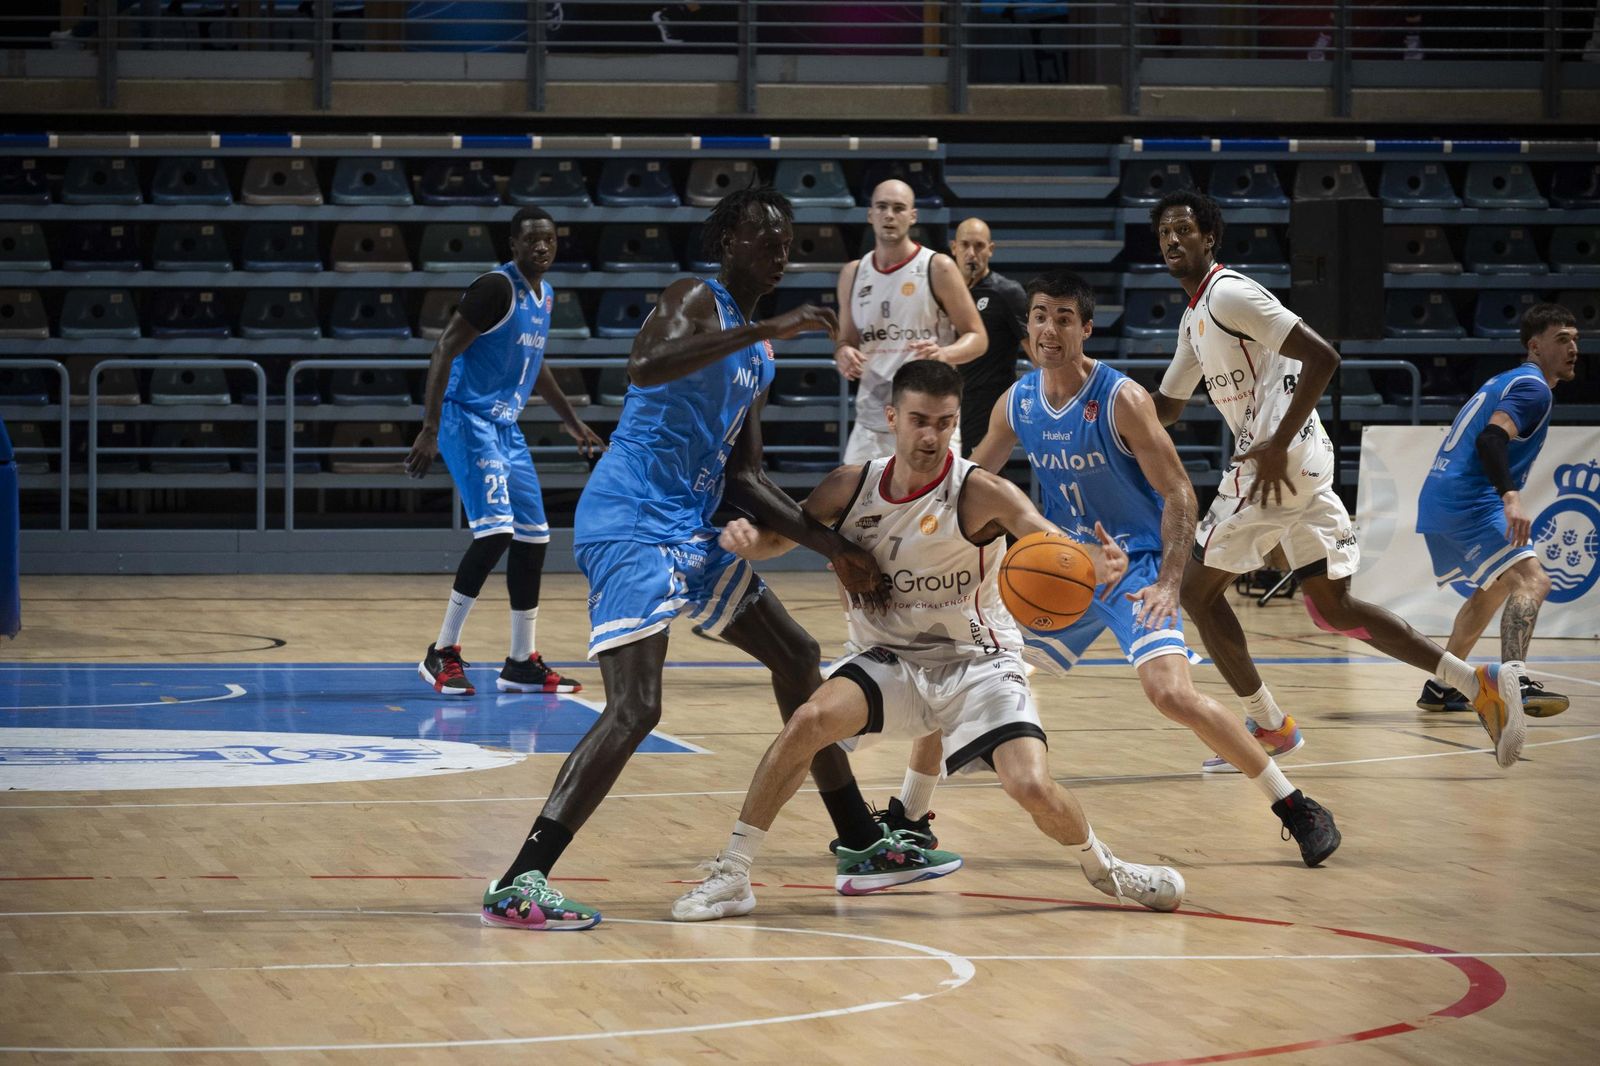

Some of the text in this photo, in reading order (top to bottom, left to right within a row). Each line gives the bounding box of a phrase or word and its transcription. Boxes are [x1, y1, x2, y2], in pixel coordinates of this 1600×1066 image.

[882, 300, 891, 318] 8
[1042, 431, 1072, 441] Huelva
[484, 474, 510, 505] 23
[1059, 481, 1086, 517] 11
[889, 536, 902, 561] 7
